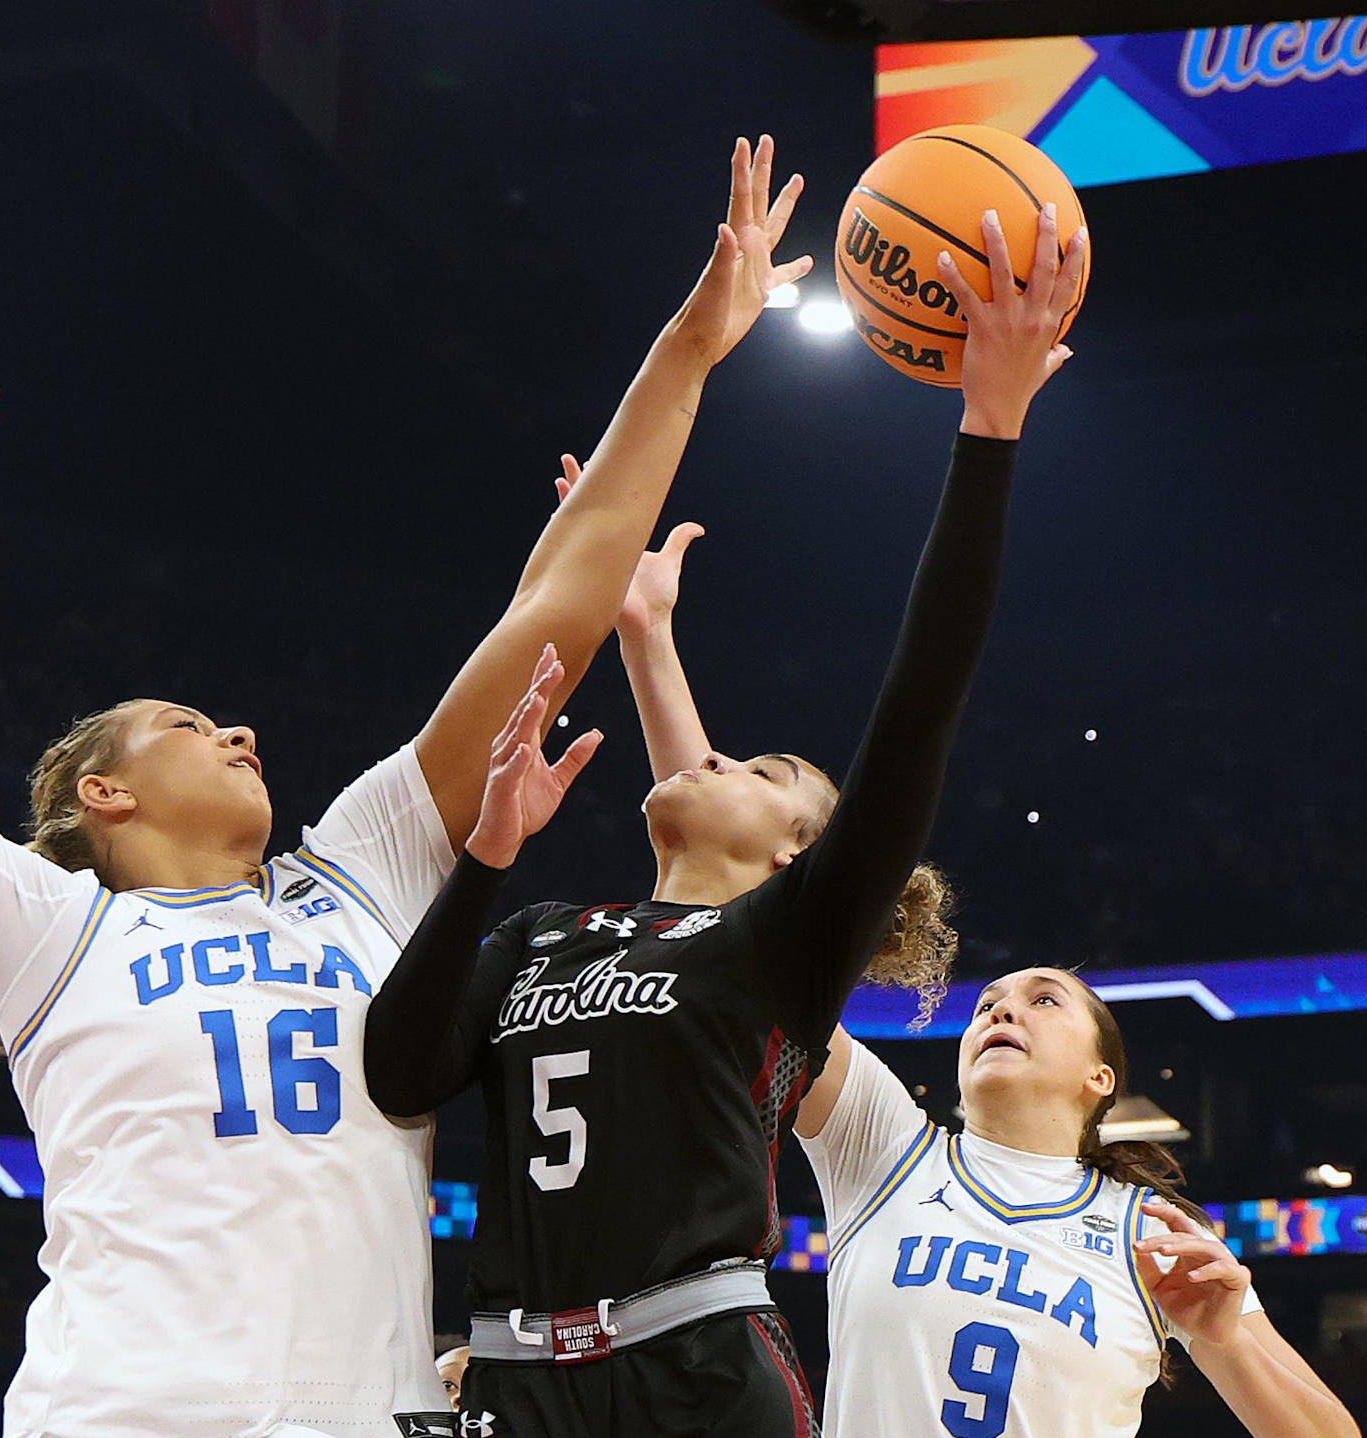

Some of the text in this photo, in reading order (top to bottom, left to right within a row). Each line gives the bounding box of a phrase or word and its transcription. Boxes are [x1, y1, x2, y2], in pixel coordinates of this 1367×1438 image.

[129, 931, 372, 1006] UCLA
[490, 949, 679, 1043] Carolina
[199, 1008, 341, 1138] 16
[529, 1050, 590, 1191] 5
[556, 1323, 601, 1340] CAROLINA
[892, 1235, 1098, 1348] UCLA
[564, 1337, 595, 1352] SOUTH
